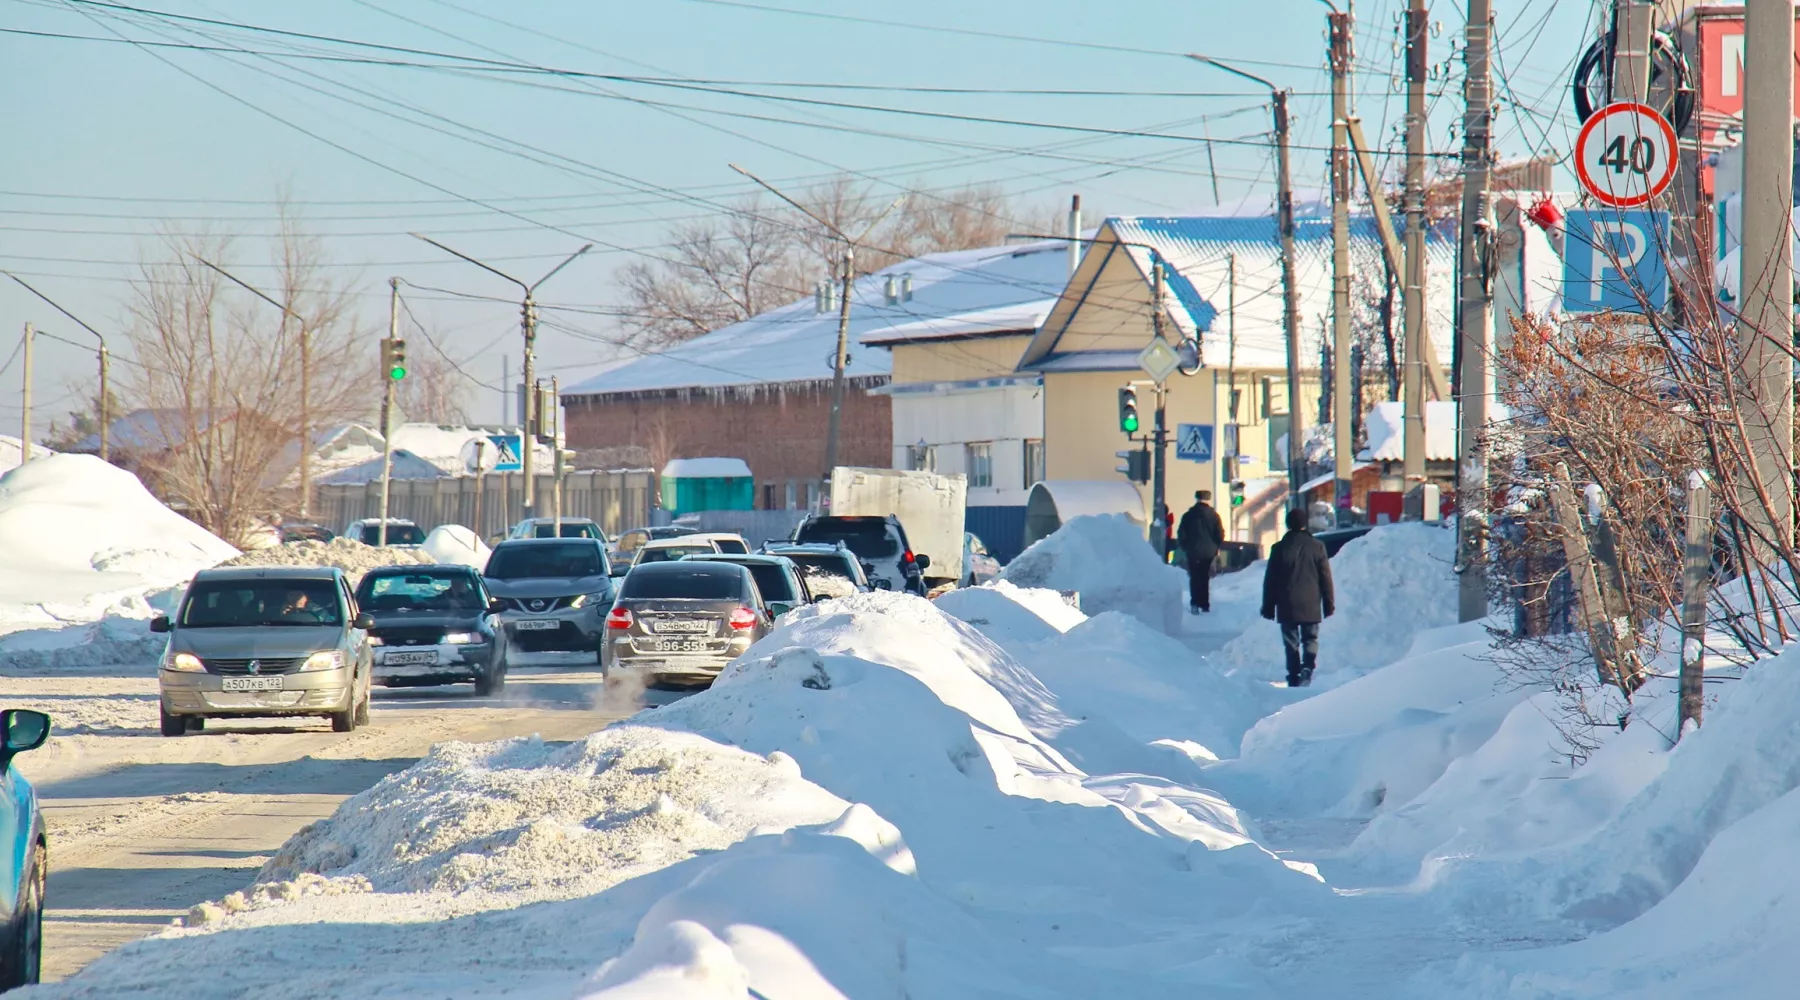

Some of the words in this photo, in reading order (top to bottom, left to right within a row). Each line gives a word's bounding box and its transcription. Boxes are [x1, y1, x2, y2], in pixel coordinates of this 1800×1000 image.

[1598, 135, 1655, 174] 40
[1590, 221, 1646, 301] P
[655, 641, 706, 651] 996-559
[226, 679, 264, 689] А507КВ
